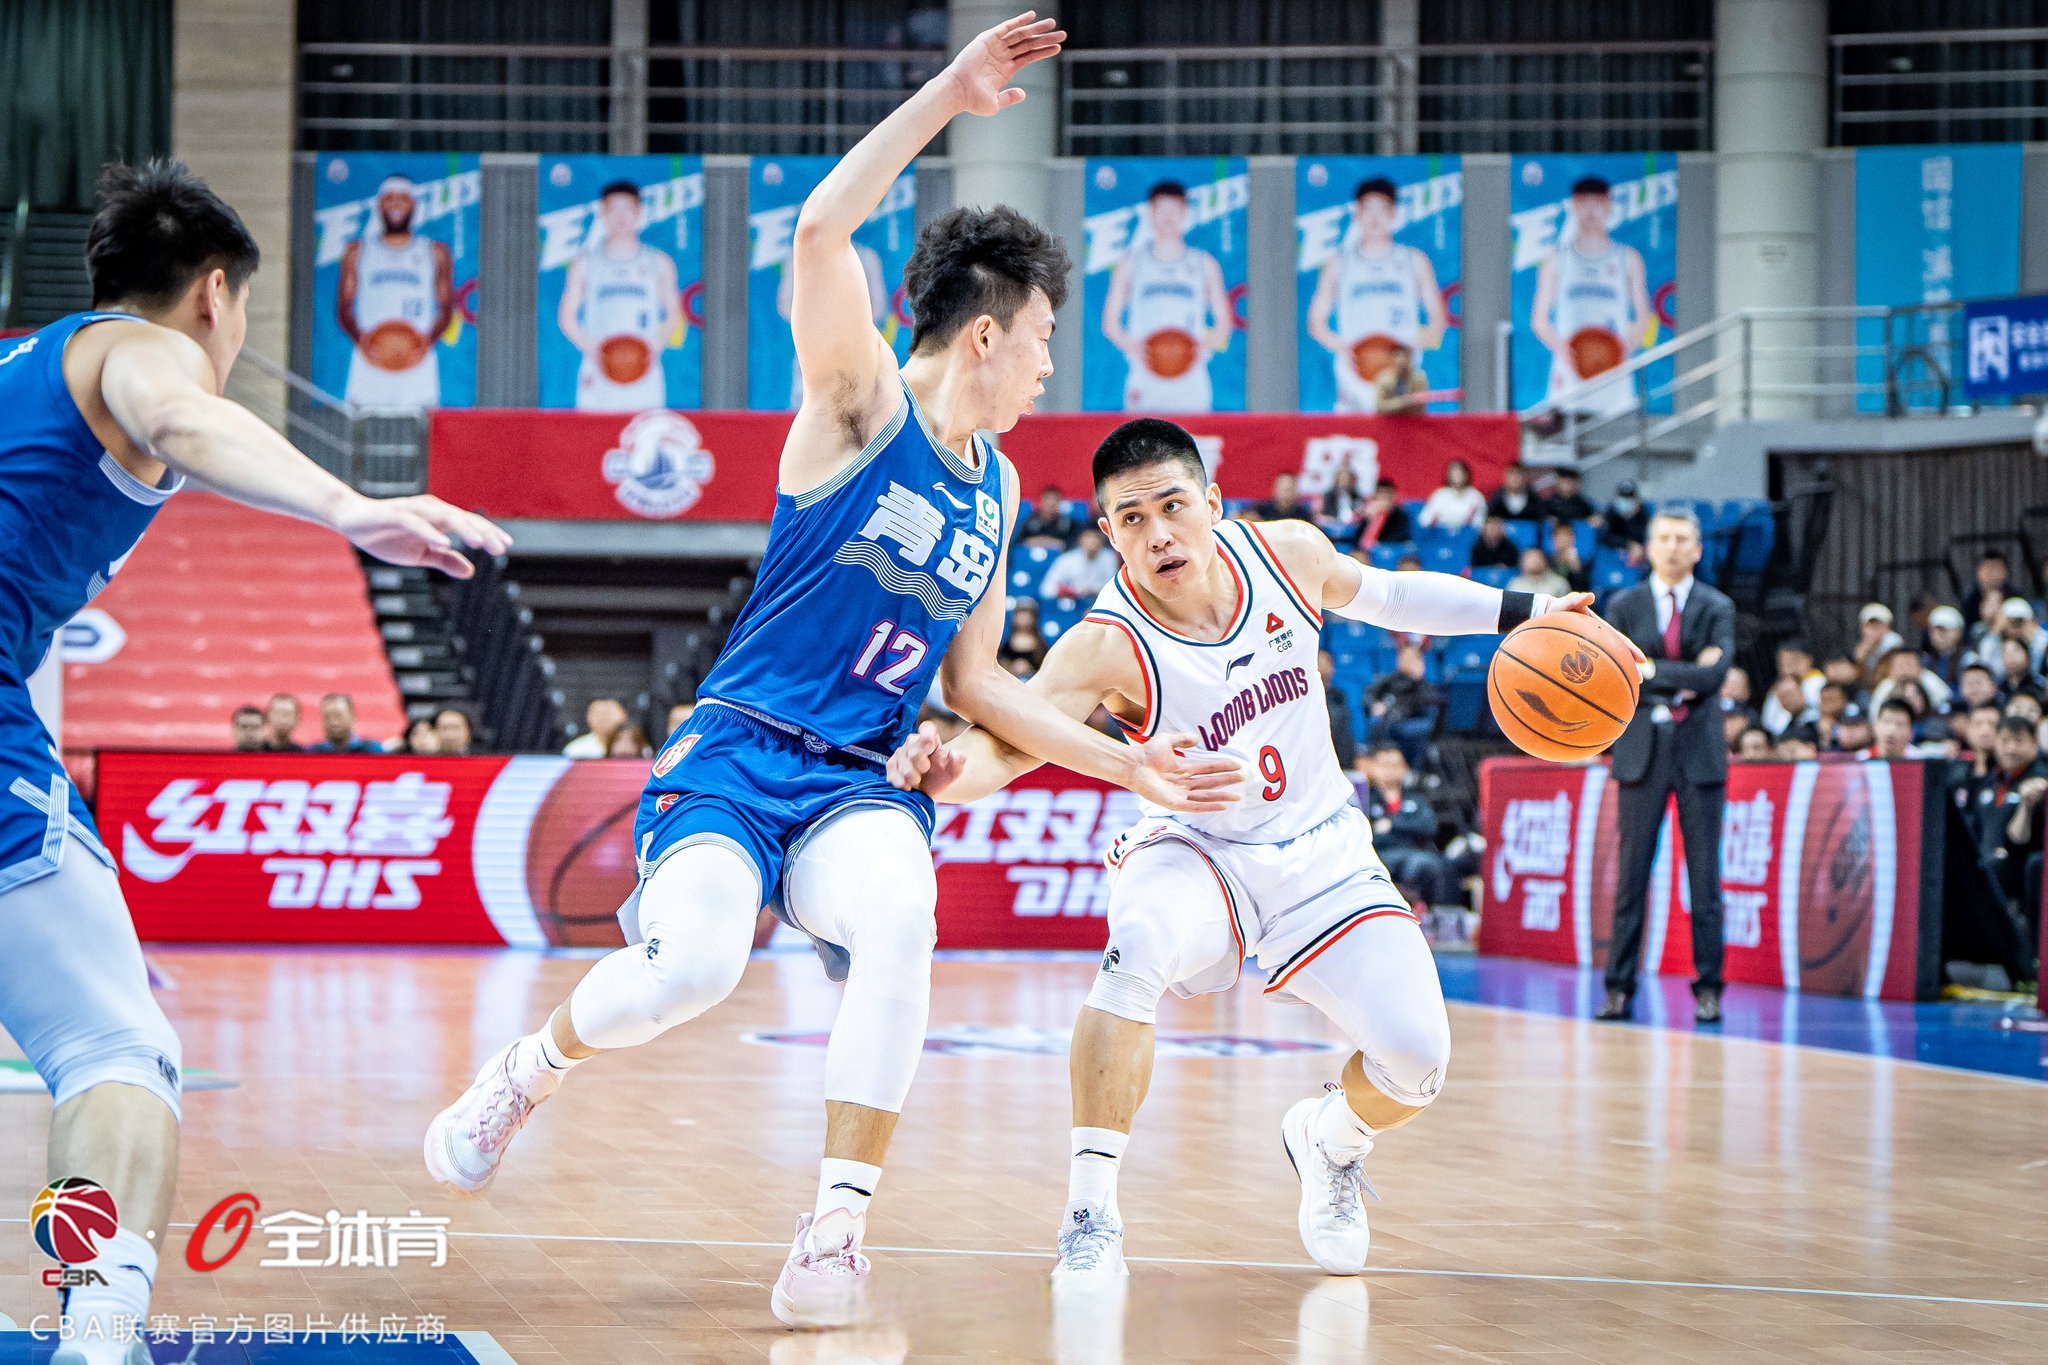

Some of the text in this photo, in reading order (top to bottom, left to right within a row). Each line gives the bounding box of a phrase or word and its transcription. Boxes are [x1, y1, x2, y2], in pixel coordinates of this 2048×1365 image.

[857, 480, 995, 604] 青岛
[850, 619, 928, 696] 12
[1277, 640, 1293, 653] CGB
[1259, 745, 1287, 801] 9
[123, 772, 455, 883] 红双喜
[262, 858, 442, 910] DHS
[1006, 866, 1108, 918] DH
